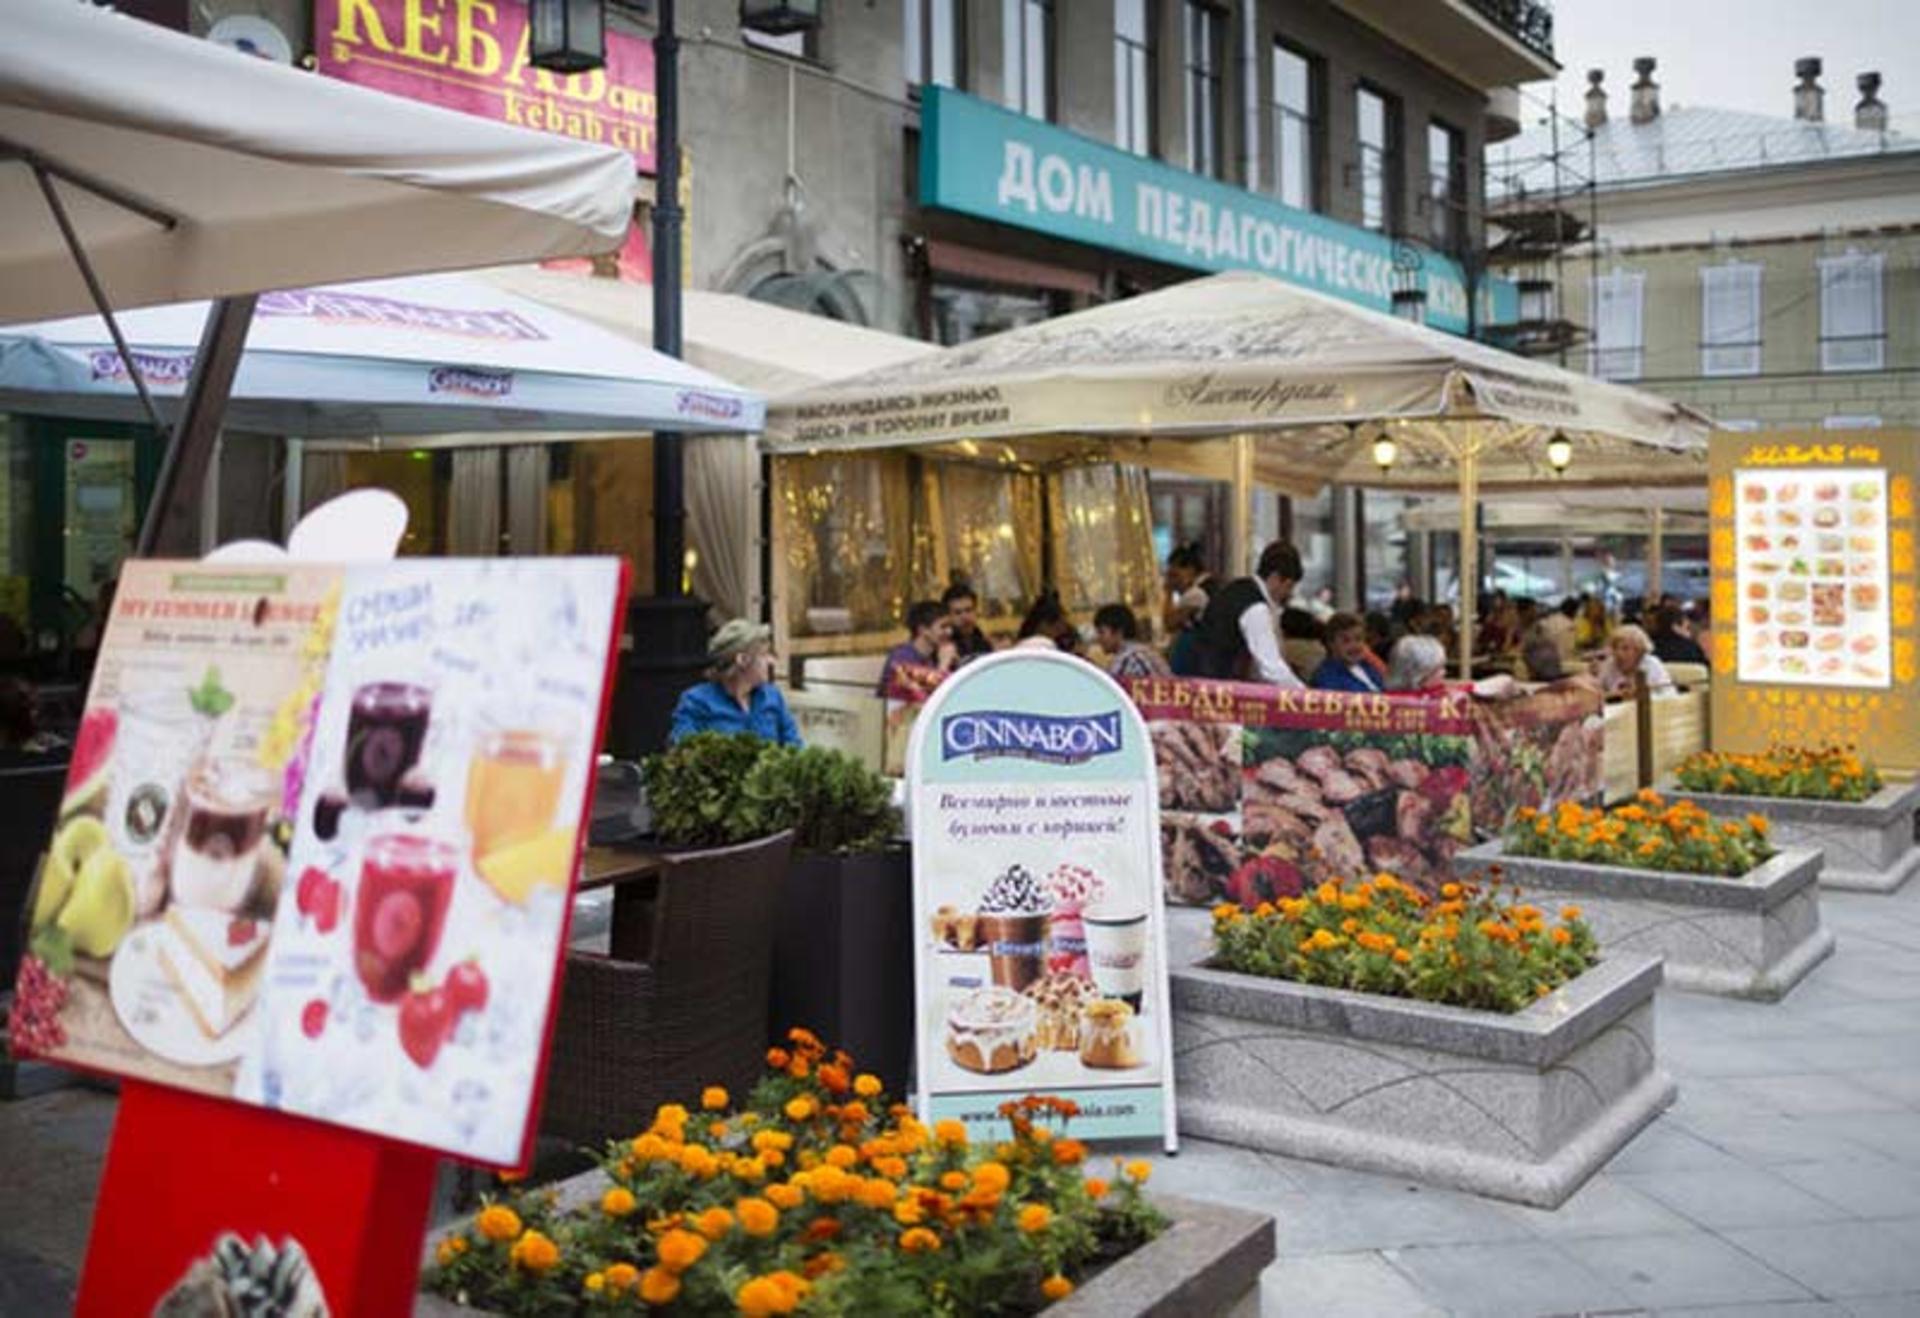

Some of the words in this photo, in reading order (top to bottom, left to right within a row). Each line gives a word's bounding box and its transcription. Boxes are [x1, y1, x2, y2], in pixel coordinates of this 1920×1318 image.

[505, 88, 604, 142] kebab
[612, 121, 653, 153] cit
[998, 139, 1114, 224] ДОМ
[1427, 272, 1494, 325] КНИИ
[950, 406, 1010, 427] ВРЕМЯ
[1131, 679, 1234, 712] КЕБАБ
[1279, 689, 1390, 717] КЕБАБ
[945, 716, 1119, 752] CINNABON
